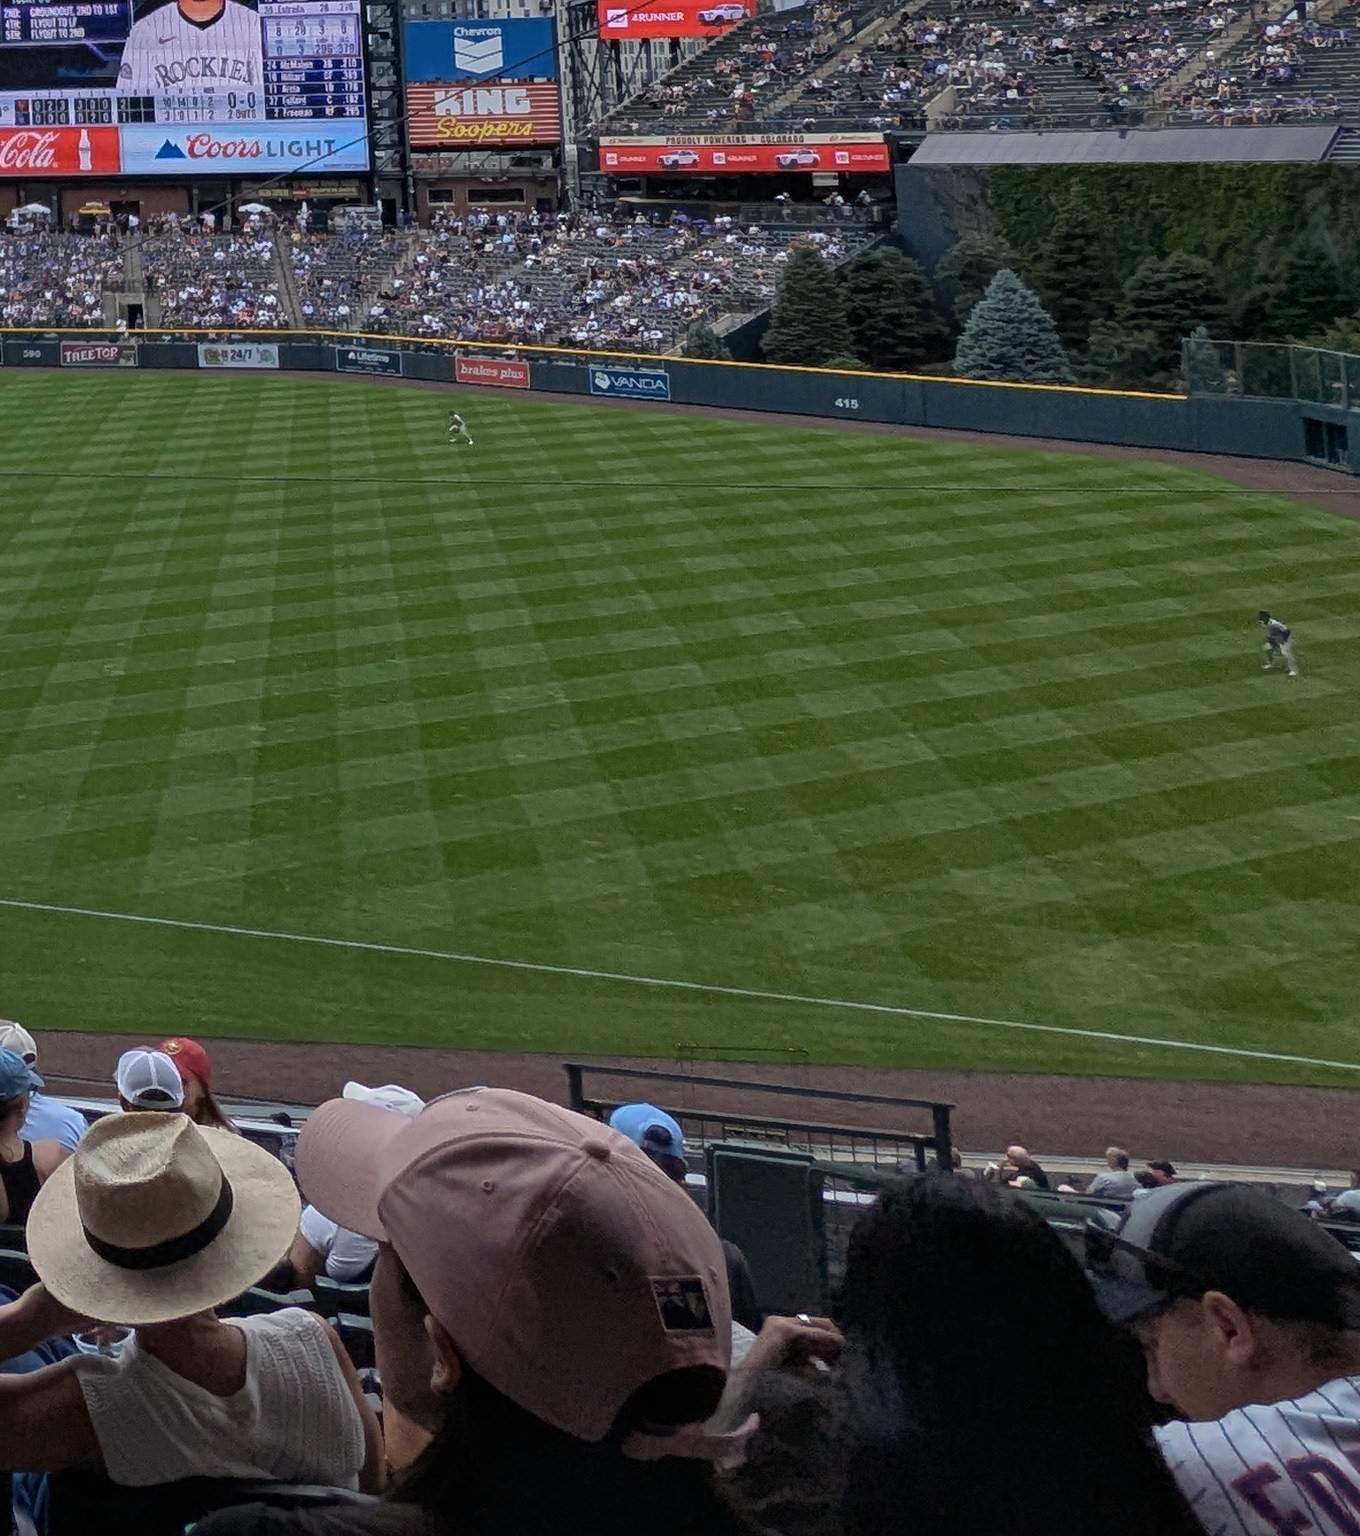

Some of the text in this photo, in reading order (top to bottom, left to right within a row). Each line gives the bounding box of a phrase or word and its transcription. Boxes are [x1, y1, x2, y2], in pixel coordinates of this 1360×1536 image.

[631, 11, 684, 22] 4RUNNER
[454, 27, 502, 37] Chevron
[434, 89, 531, 116] KING
[436, 117, 532, 143] Soopers
[186, 133, 335, 159] Coors LIGHT
[704, 135, 747, 145] POWERING
[461, 363, 524, 380] brakes plus
[834, 398, 859, 409] 415
